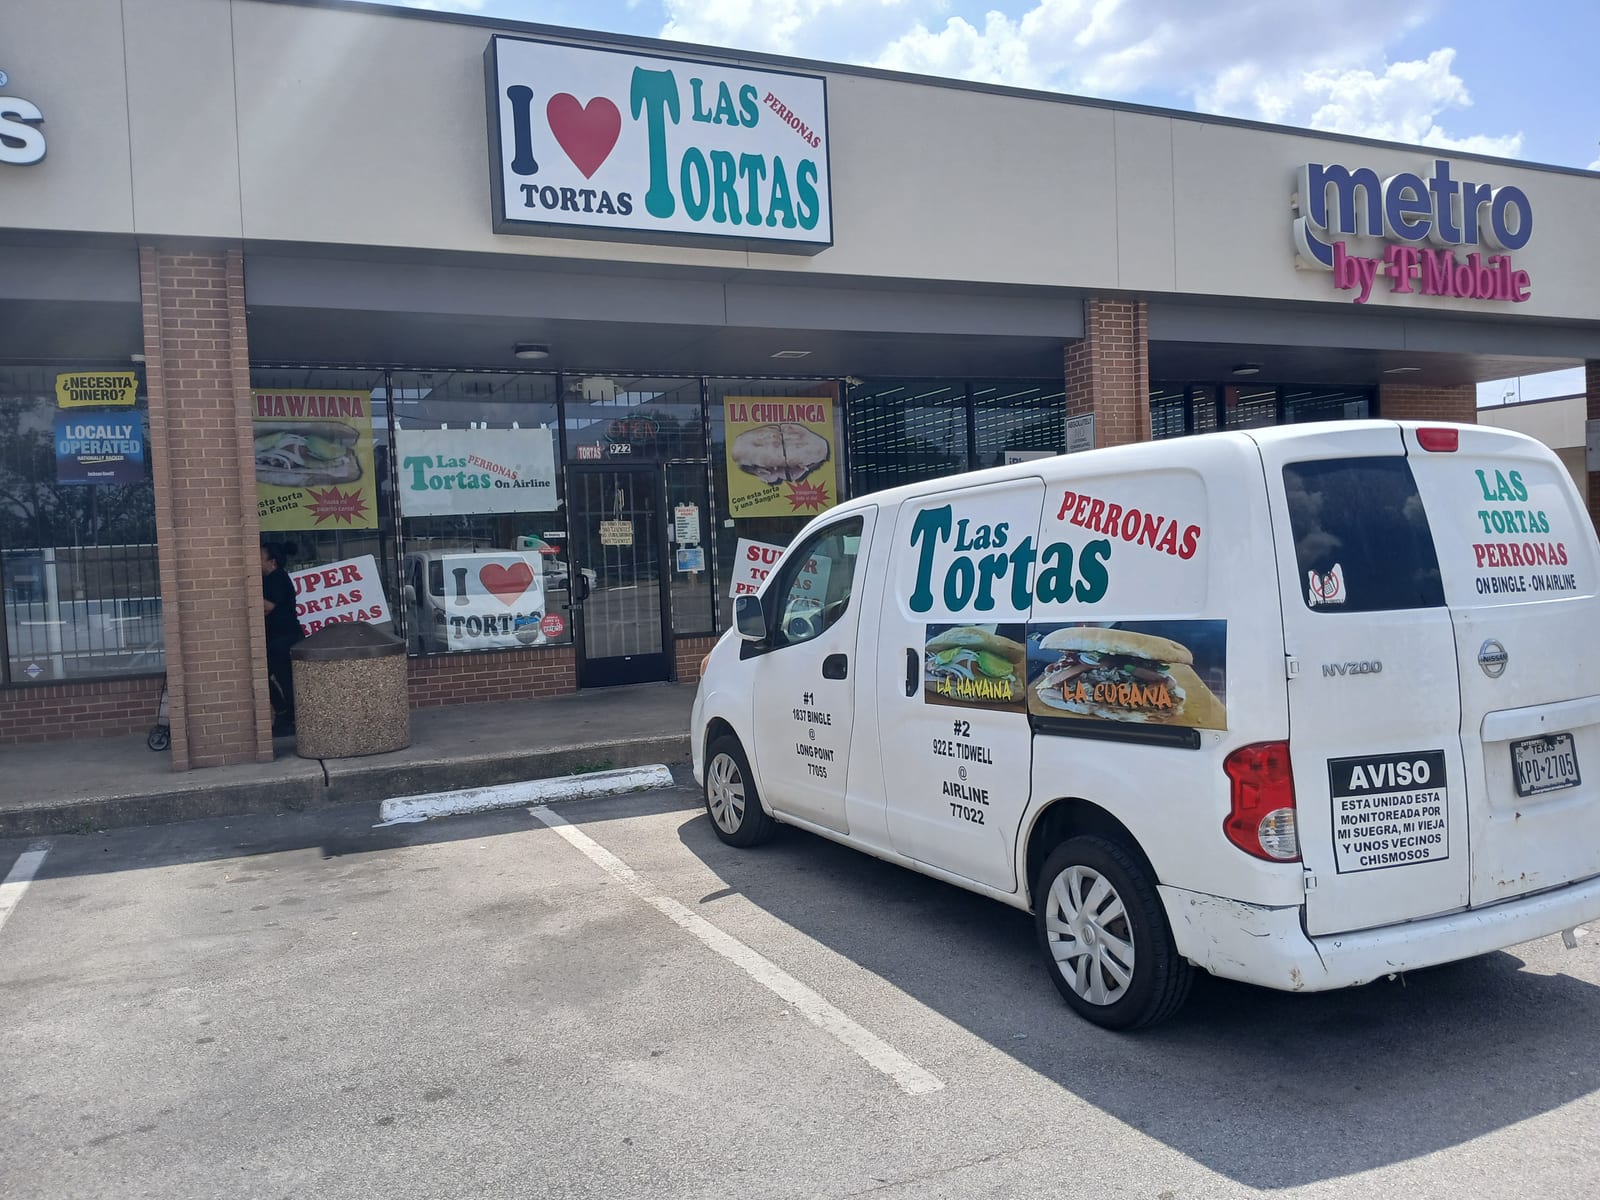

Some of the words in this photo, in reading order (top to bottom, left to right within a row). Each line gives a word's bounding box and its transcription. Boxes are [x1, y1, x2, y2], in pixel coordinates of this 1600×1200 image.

[690, 78, 760, 128] LAS
[507, 85, 539, 176] I
[763, 92, 821, 149] PERRONAS
[630, 66, 820, 231] TORTAS
[520, 184, 633, 216] TORTAS
[1302, 160, 1533, 256] metro
[1333, 242, 1382, 304] by
[63, 377, 132, 391] ¿NECESITA
[70, 389, 126, 401] DINERO?
[256, 395, 364, 418] HAWAIANA
[730, 404, 748, 422] LA
[751, 404, 825, 422] CHILANGA
[66, 425, 132, 440] LOCALLY
[60, 440, 140, 454] OPERATED
[578, 446, 602, 460] TORTAS
[610, 444, 631, 454] 922
[436, 455, 467, 468] Las
[467, 455, 518, 480] PERRONAS
[403, 455, 491, 491] Tortas
[494, 480, 510, 489] On
[513, 479, 551, 488] Airline
[1474, 469, 1528, 502] LAS
[278, 491, 303, 505] torta
[731, 496, 746, 504] Con
[763, 486, 780, 496] torta
[270, 501, 298, 514] Fanta
[1057, 491, 1201, 560] PERRONAS
[1477, 510, 1550, 534] TORTAS
[954, 519, 1009, 552] Las
[909, 504, 1111, 613] Tortas
[1472, 542, 1568, 568] PERRONAS
[294, 564, 363, 596] PER
[452, 568, 470, 606] I
[1475, 577, 1491, 595] ON
[1492, 575, 1527, 594] BINGLE
[1531, 575, 1546, 592] ON
[1546, 574, 1576, 591] AIRLINE
[296, 589, 363, 617] ORTAS
[300, 605, 382, 636] RNAS
[450, 611, 541, 639] TORT
[1482, 653, 1507, 663] NISSAN
[1322, 661, 1383, 677] NV200
[937, 675, 952, 696] LA
[1063, 680, 1087, 702] LA
[1094, 681, 1172, 709] CUBANA
[803, 692, 814, 705] #1
[793, 708, 807, 722] 1837
[807, 710, 832, 726] BINGLE
[808, 728, 816, 740] @
[953, 719, 970, 737] #2
[796, 743, 814, 757] LONG
[814, 746, 834, 762] POINT
[933, 738, 946, 756] 922
[947, 741, 955, 757] E.
[956, 743, 993, 765] TIDWELL
[1531, 744, 1556, 755] TEXAS
[807, 763, 828, 778] 77055
[958, 765, 968, 781] @
[1349, 760, 1431, 790] AVISO
[942, 781, 990, 806] AIRLINE
[1341, 799, 1371, 811] ESTA
[1373, 794, 1413, 808] UNIDAD
[1415, 792, 1440, 804] ESTA
[950, 802, 985, 825] 77022
[1341, 808, 1421, 825] MONITOREADA
[1422, 806, 1440, 816] POR
[1338, 829, 1351, 839] MI
[1353, 824, 1401, 838] SUEGRA,
[1403, 822, 1415, 833] MI
[1418, 818, 1445, 831] VIEJA
[1343, 843, 1351, 854] Y
[1353, 840, 1389, 853] UNOS
[1391, 833, 1442, 849] VECINOS
[1360, 848, 1430, 866] CHISMOSOS
